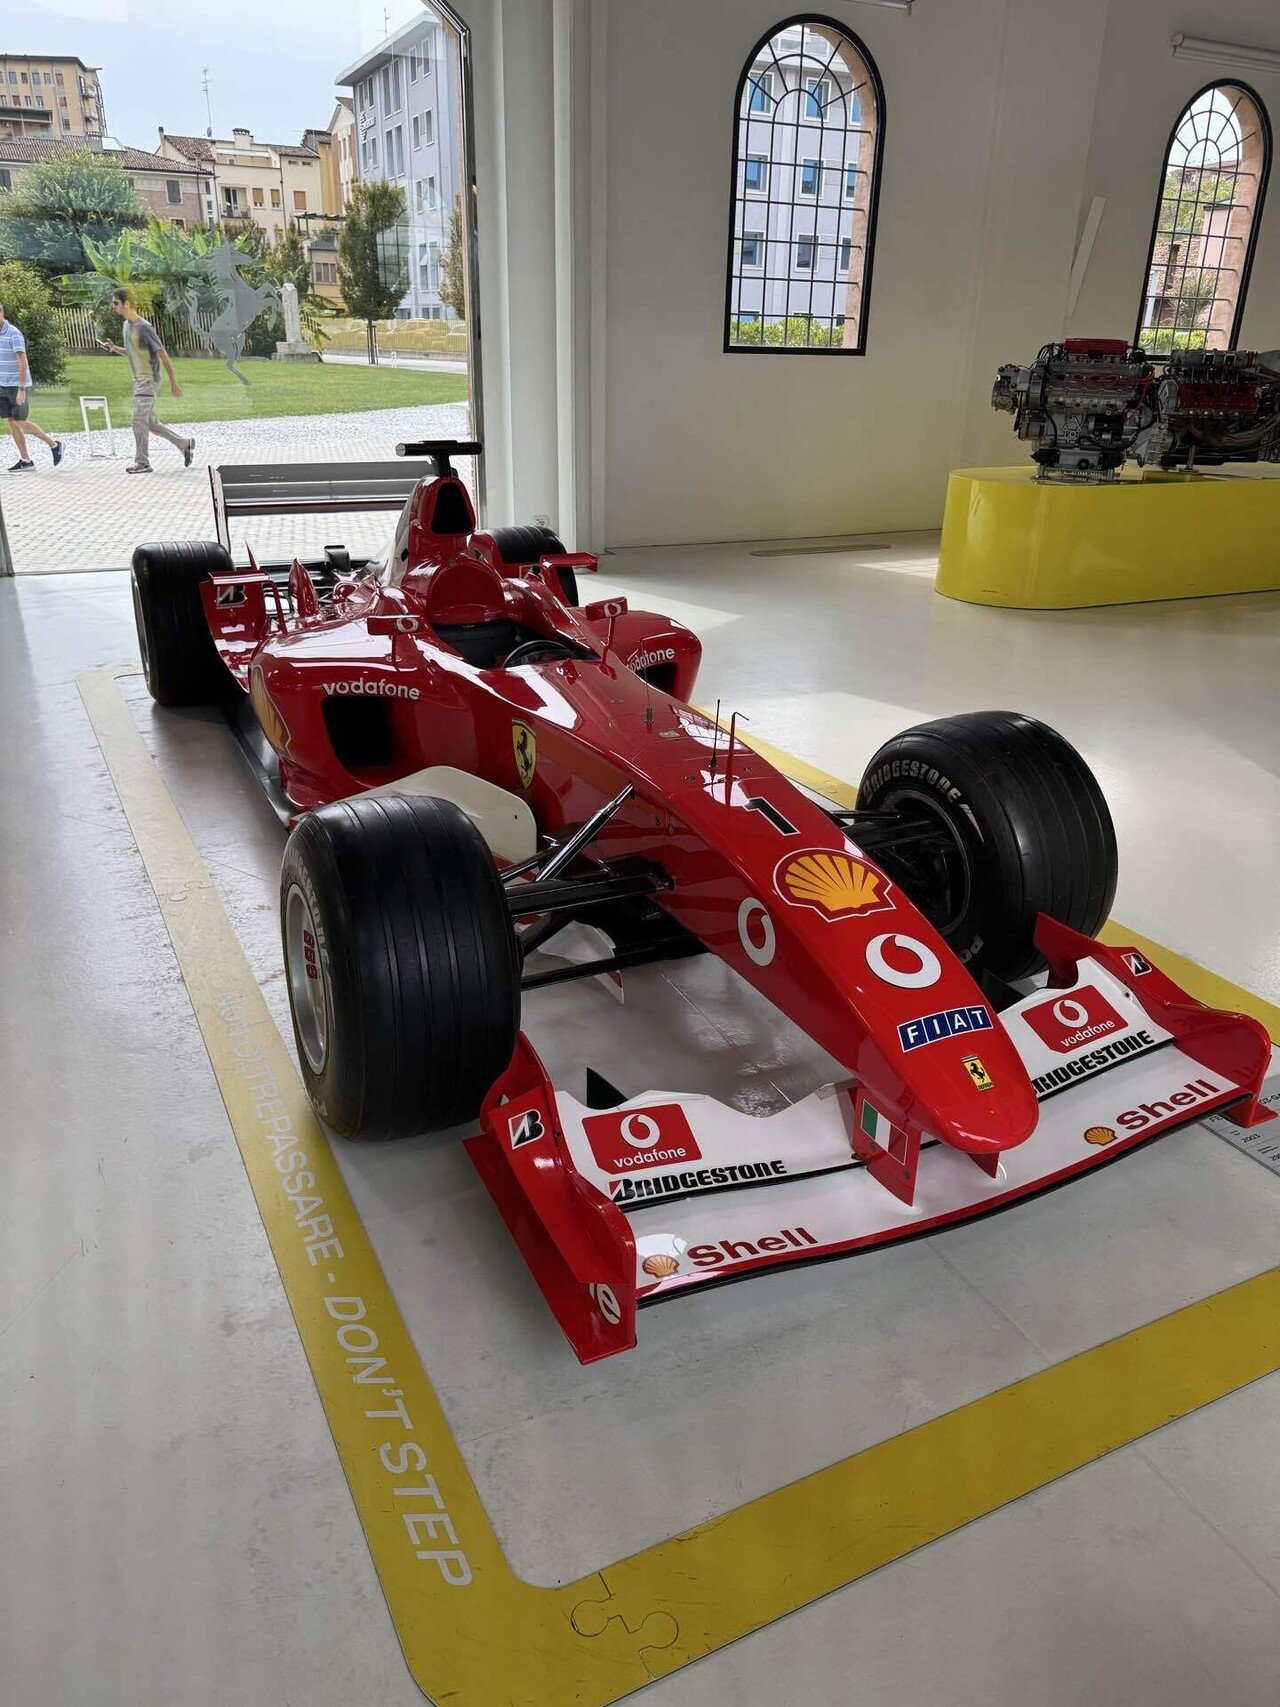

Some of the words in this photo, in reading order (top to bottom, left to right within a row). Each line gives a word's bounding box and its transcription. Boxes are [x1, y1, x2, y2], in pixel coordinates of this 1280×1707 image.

[322, 677, 420, 700] vodafone
[861, 759, 963, 806] BRIDGESTONE
[742, 796, 801, 836] 1
[904, 1009, 986, 1046] FIAT
[1060, 1020, 1116, 1048] vodafone
[1032, 1029, 1155, 1095] RIDGESTONE
[1115, 1078, 1222, 1131] Shell
[612, 1146, 688, 1170] vodafone
[608, 1159, 788, 1202] BRIDGESTONE
[686, 1226, 819, 1267] Shell
[233, 1038, 345, 1268] OLTREPASSARE
[323, 1295, 414, 1431] DON'T
[378, 1441, 474, 1587] STEP
